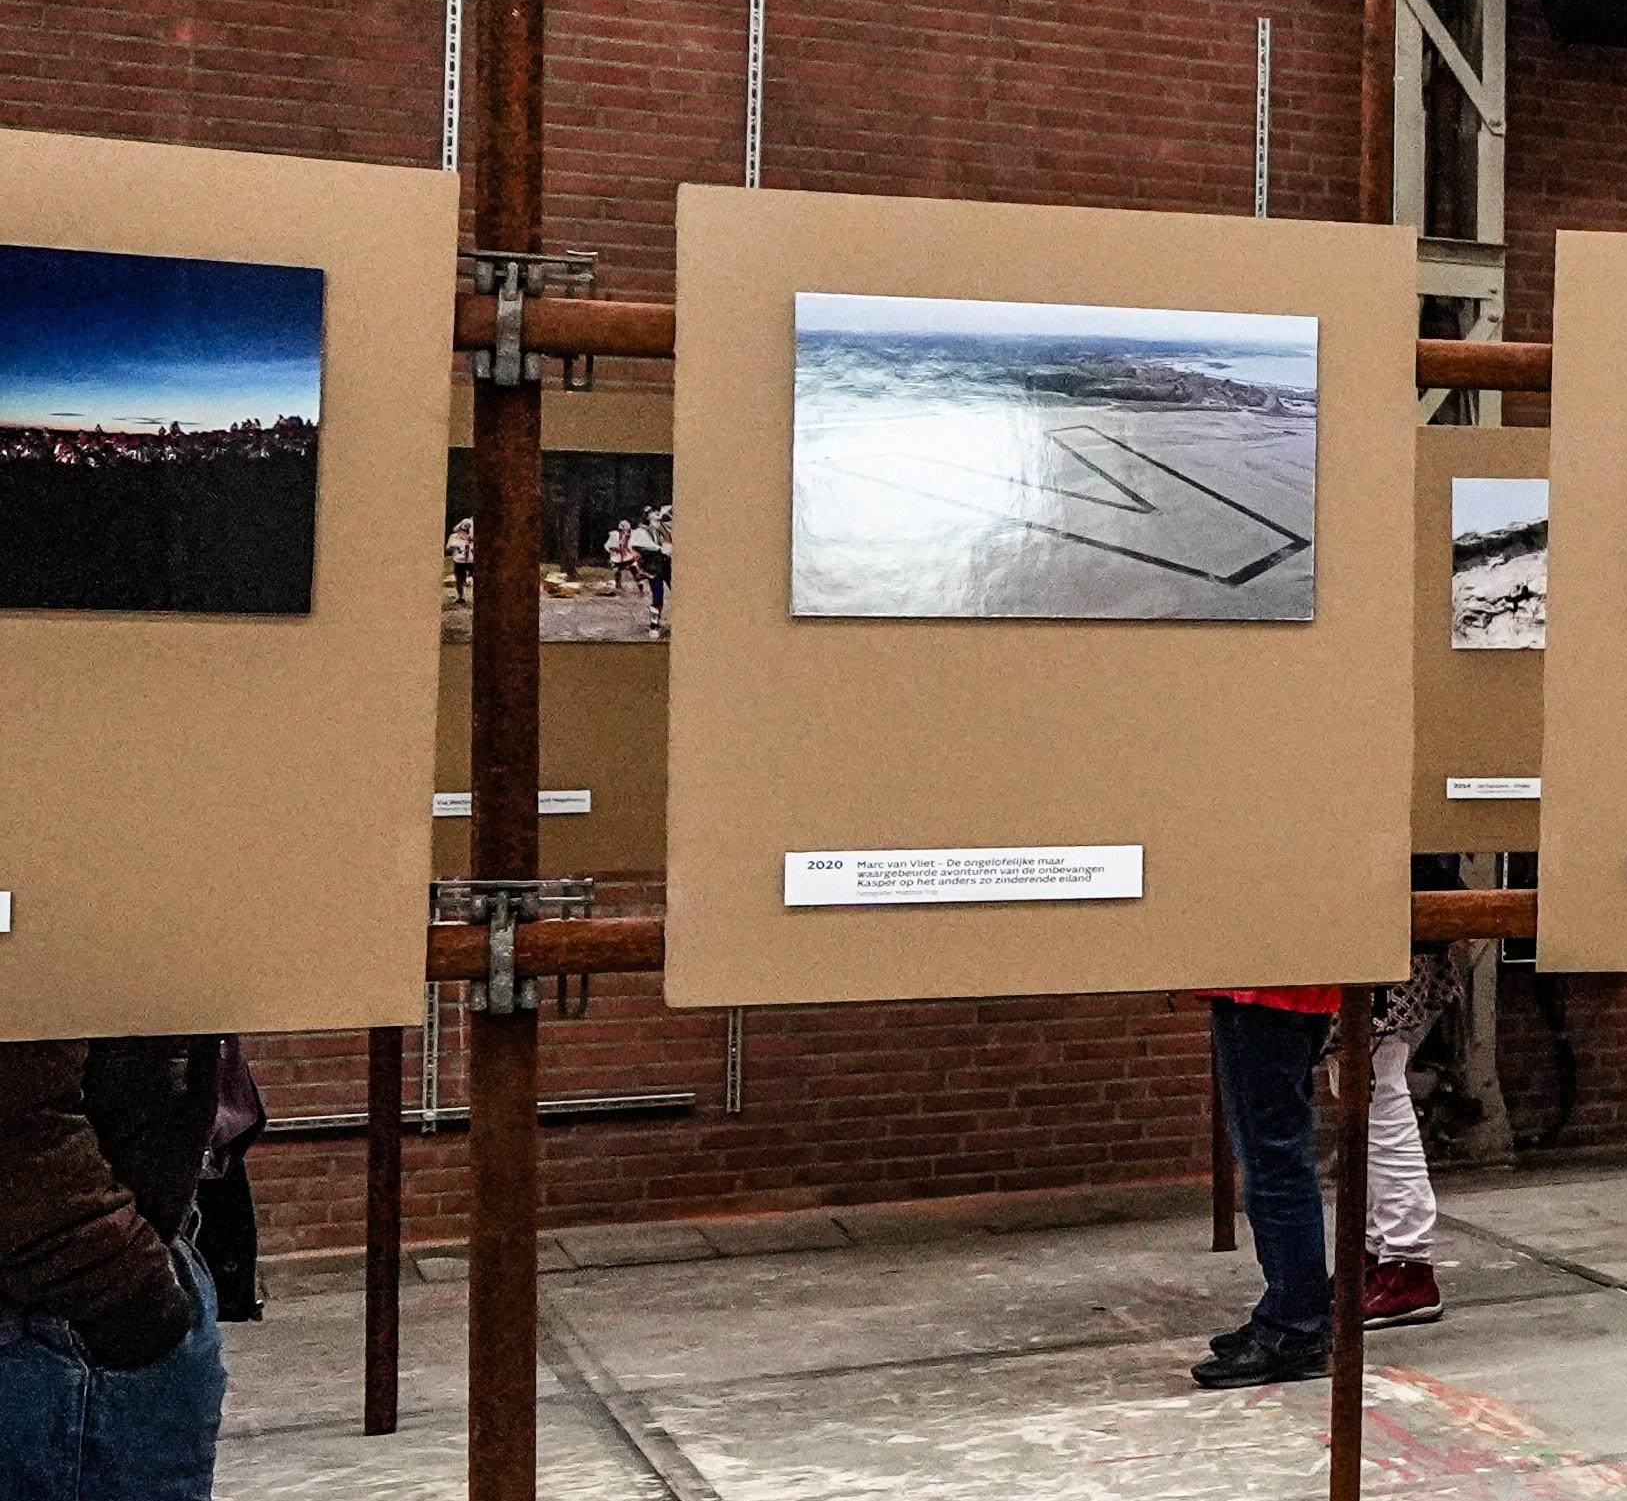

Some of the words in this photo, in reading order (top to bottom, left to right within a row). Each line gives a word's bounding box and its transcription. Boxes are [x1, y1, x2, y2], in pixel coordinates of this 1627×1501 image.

[806, 860, 843, 870] 2020
[857, 860, 885, 869] Marc
[887, 860, 907, 868] van
[909, 859, 935, 868] Vliet
[946, 858, 961, 867] De
[964, 858, 1035, 869] ongelofelijke
[1038, 857, 1065, 866] maar
[857, 868, 938, 879] waargebeurde
[940, 867, 997, 877] avonturen
[1000, 867, 1019, 875] van
[1022, 866, 1035, 875] de
[1038, 865, 1105, 876] onbevangen
[857, 879, 897, 888] Kasper
[899, 879, 914, 888] op
[916, 877, 935, 887] het
[938, 877, 976, 886] anders
[979, 877, 992, 885] zo
[995, 875, 1056, 884] zinderende
[1058, 873, 1092, 883] eiland
